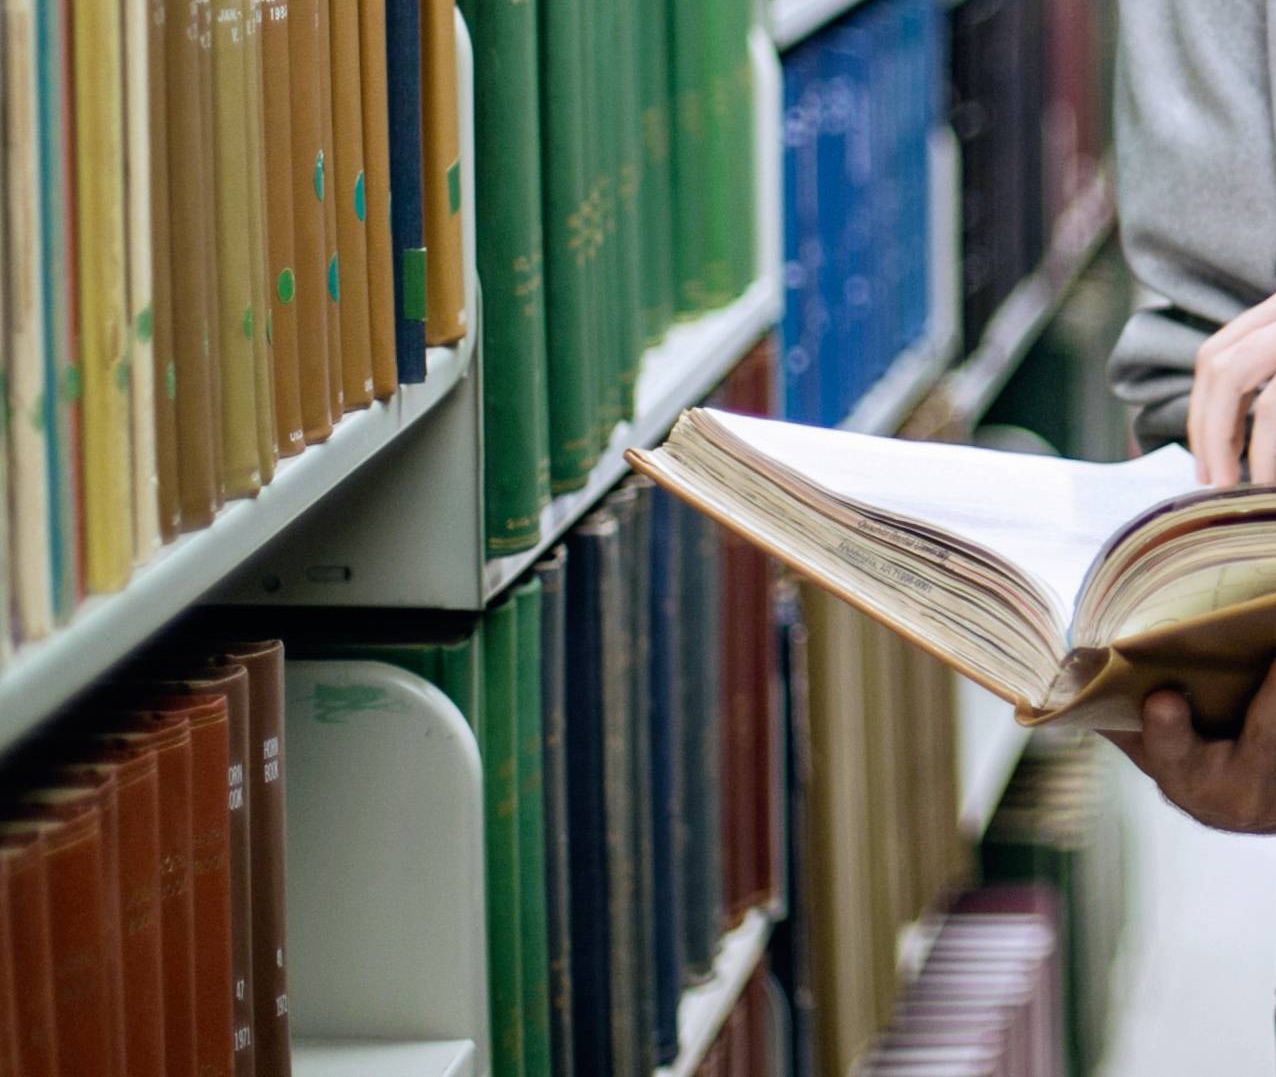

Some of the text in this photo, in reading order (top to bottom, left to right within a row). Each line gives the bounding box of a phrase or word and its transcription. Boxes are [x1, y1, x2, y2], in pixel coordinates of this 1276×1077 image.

[228, 764, 243, 787] ORN
[229, 788, 244, 811] OOK
[234, 1027, 251, 1051] 1971
